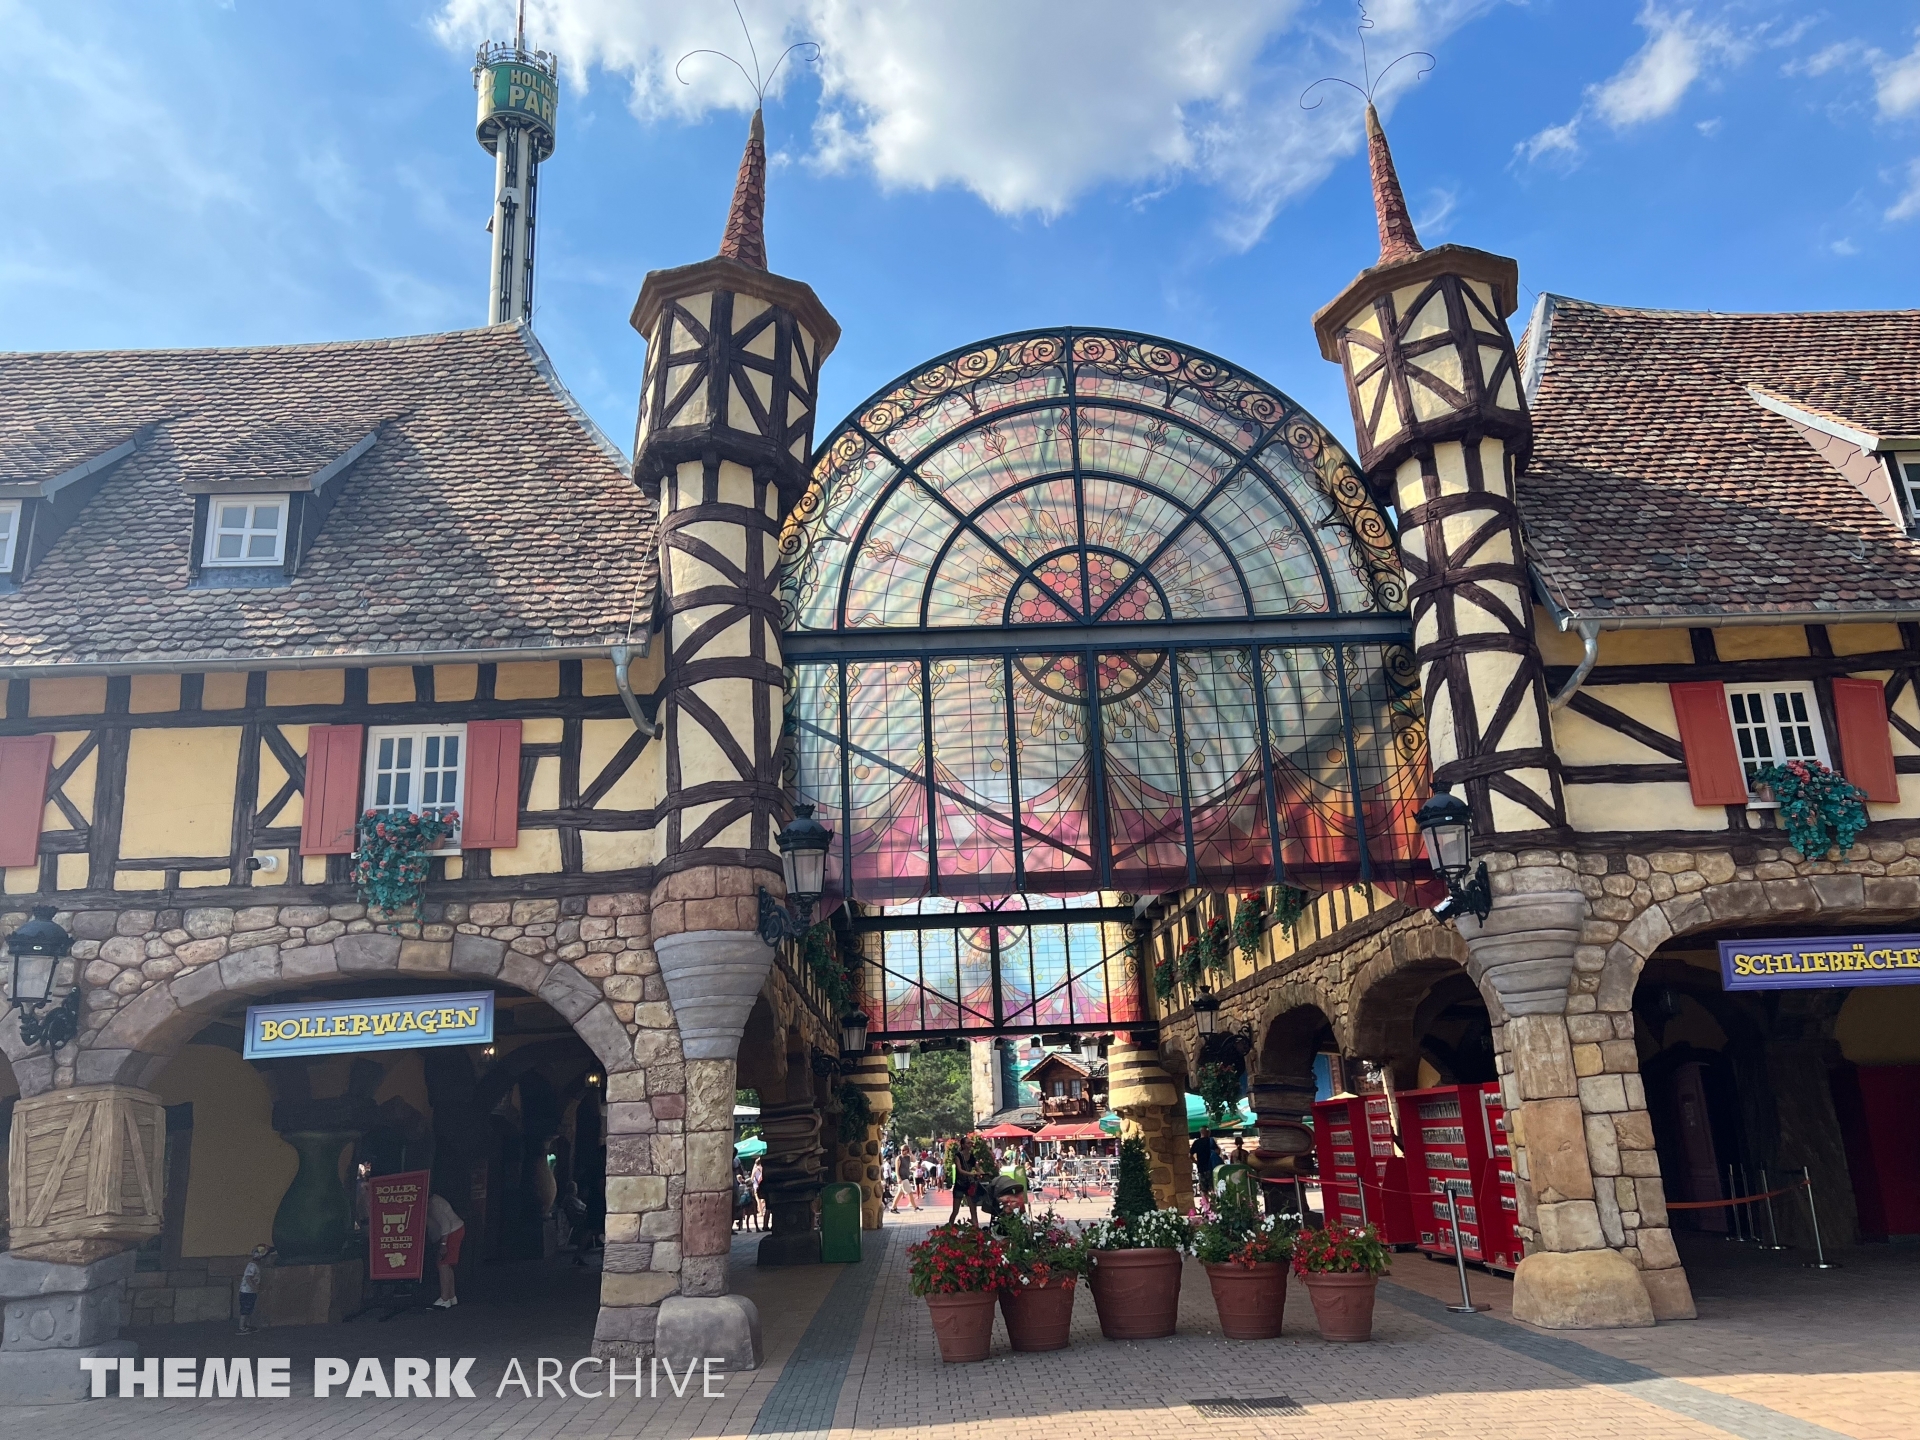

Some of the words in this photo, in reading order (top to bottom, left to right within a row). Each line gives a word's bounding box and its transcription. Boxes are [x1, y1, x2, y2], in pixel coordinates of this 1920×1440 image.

[1734, 943, 1920, 975] SCHLIEßFÄCHE
[260, 1006, 480, 1041] BOLLERWAGEN
[376, 1184, 421, 1195] BOLLER-
[378, 1194, 417, 1204] WAGEN
